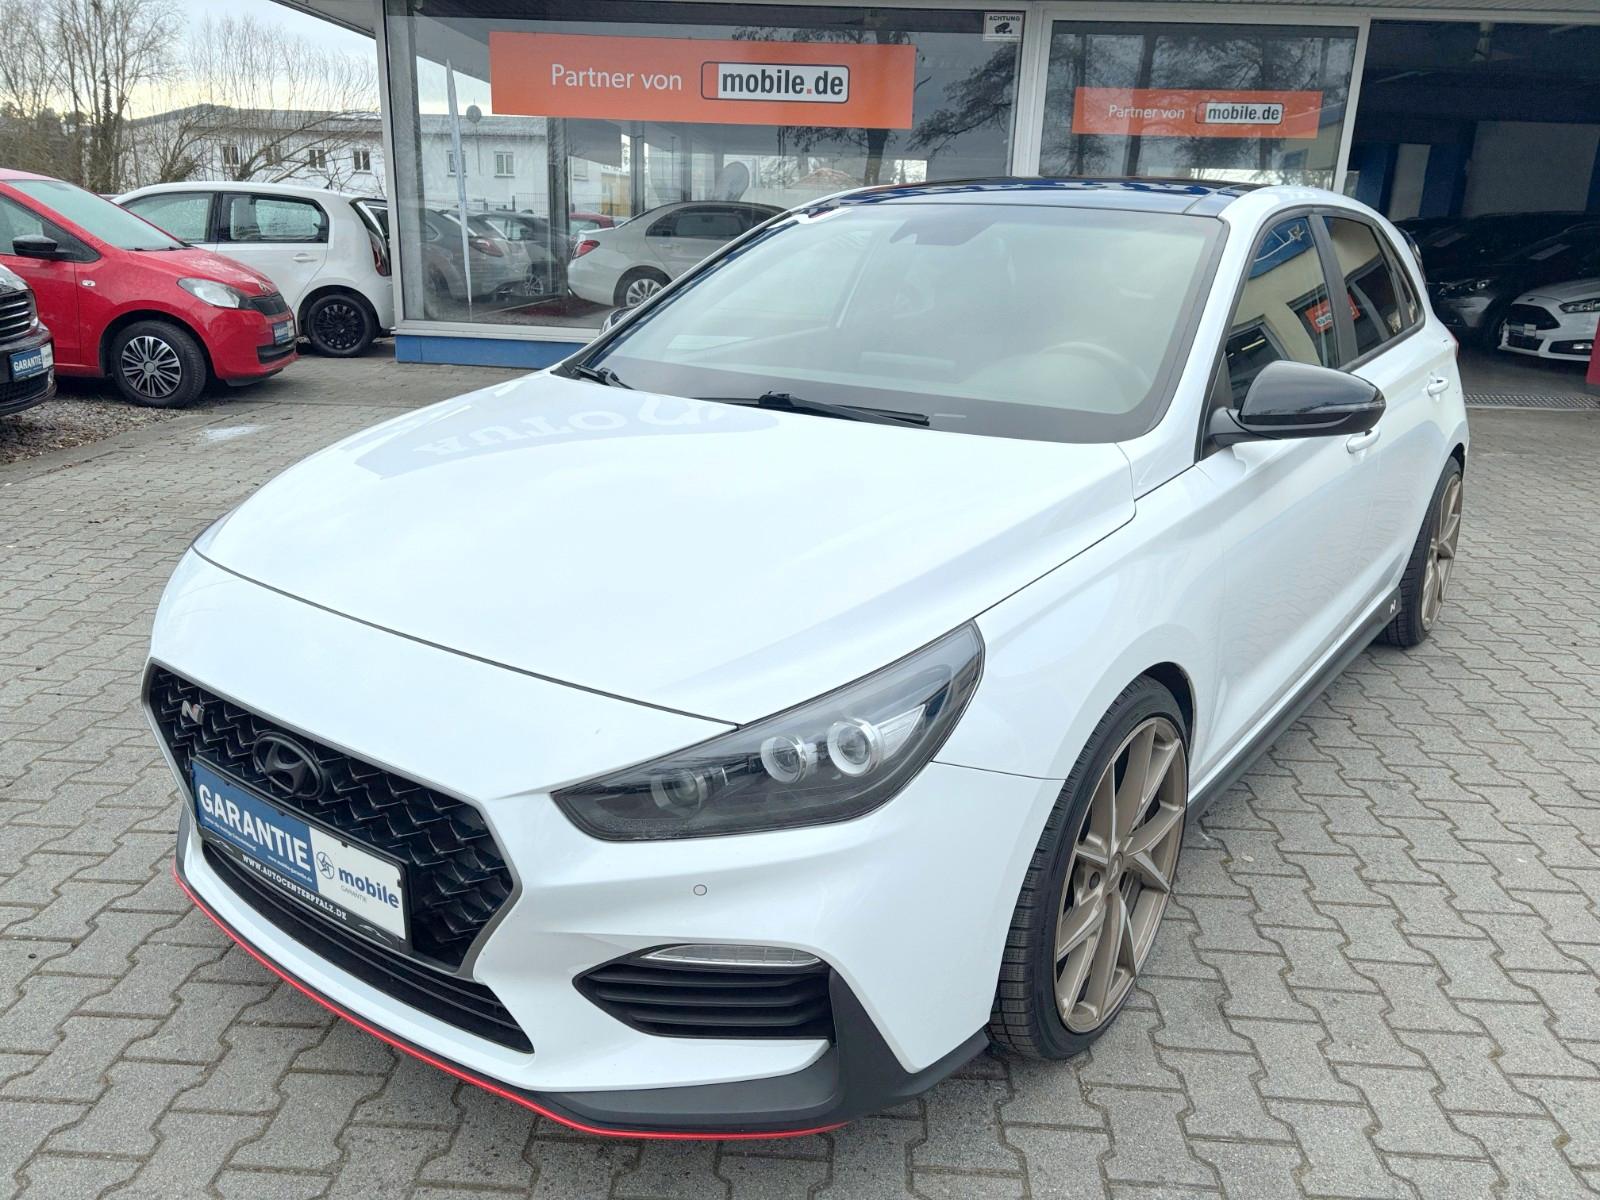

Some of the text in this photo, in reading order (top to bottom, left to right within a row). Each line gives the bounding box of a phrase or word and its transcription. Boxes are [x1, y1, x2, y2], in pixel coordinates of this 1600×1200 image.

[551, 63, 844, 96] Partner von mobile.de
[1108, 103, 1280, 121] Partner von mobile.de
[13, 355, 43, 372] GARANTIE
[198, 783, 311, 871] GARANTIE
[241, 853, 347, 921] WWW.AUTOCENTERPFALZ.DE
[338, 867, 400, 909] mobile
